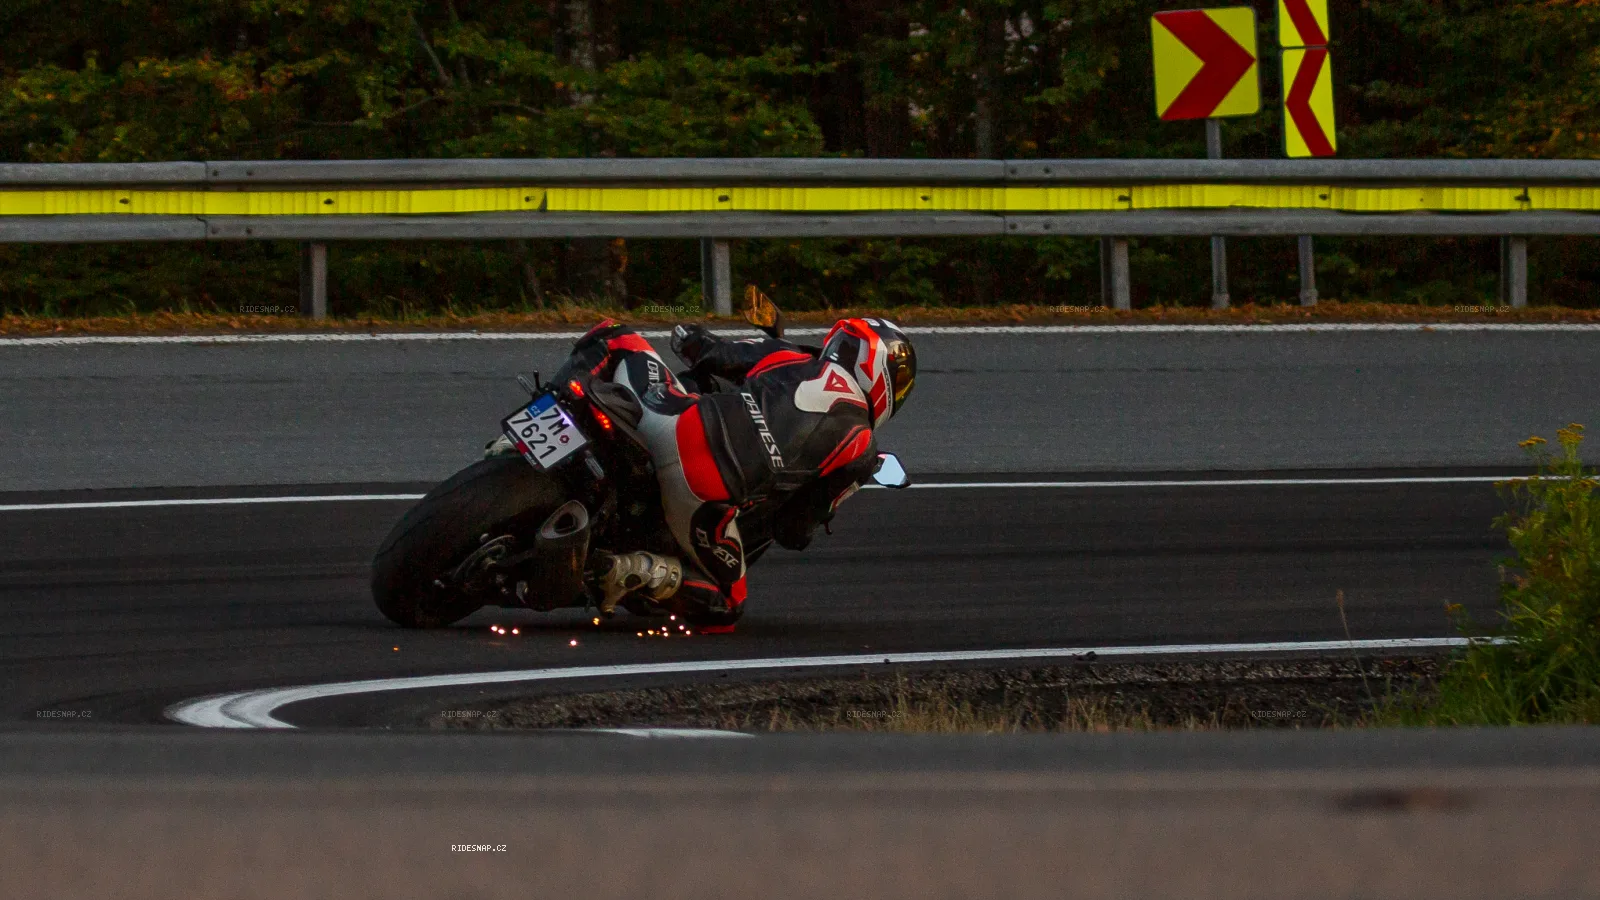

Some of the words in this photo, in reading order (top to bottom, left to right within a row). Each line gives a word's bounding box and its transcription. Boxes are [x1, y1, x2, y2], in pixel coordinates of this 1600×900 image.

[530, 405, 541, 415] CZ
[540, 407, 570, 435] 7M
[511, 411, 557, 459] 7621
[740, 392, 784, 468] DAINESE
